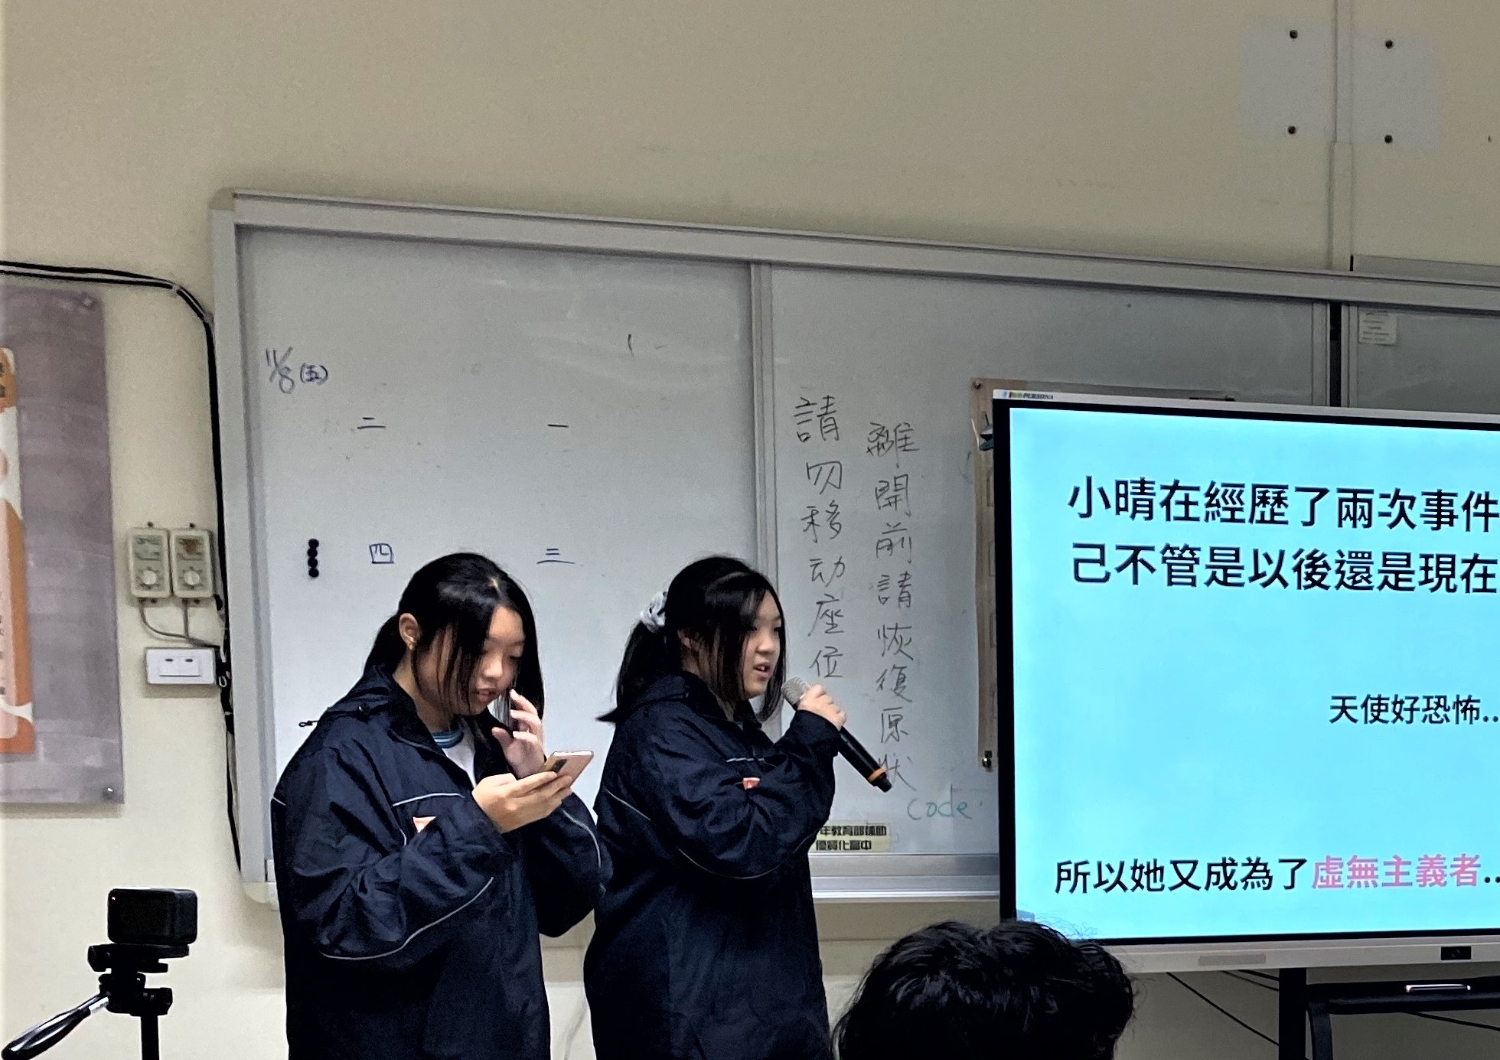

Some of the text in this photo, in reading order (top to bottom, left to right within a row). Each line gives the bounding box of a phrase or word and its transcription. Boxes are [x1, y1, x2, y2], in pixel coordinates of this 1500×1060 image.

[356, 416, 387, 430] 二
[369, 542, 395, 565] 四
[536, 547, 577, 565] 三
